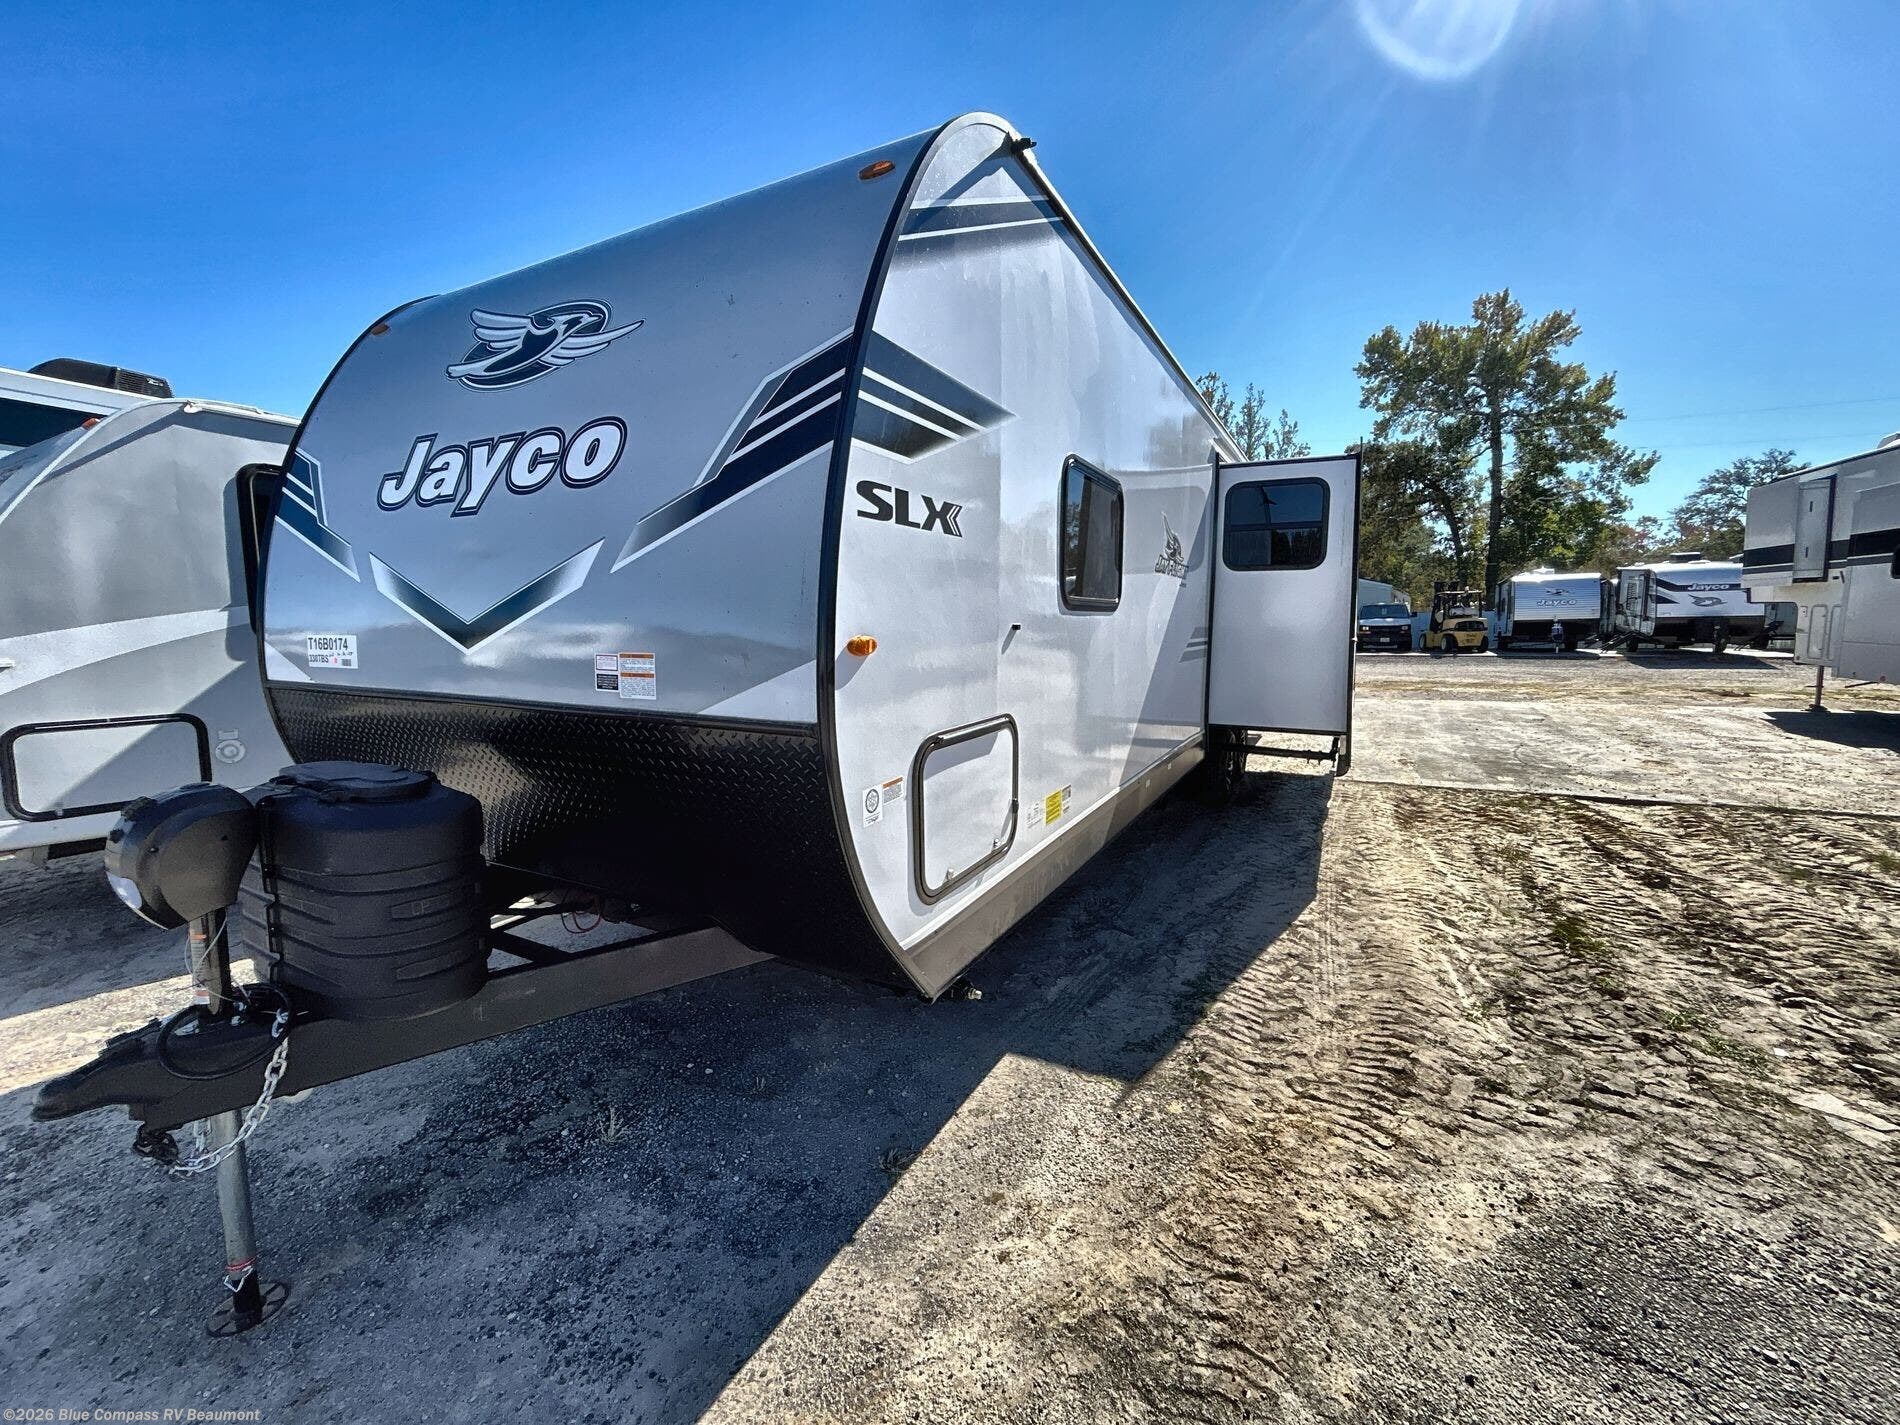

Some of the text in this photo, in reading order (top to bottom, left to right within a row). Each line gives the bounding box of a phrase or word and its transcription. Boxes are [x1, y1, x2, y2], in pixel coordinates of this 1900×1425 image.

[377, 415, 628, 518] Jayco
[856, 480, 963, 538] SLX
[1687, 582, 1730, 592] Jayco
[1536, 598, 1577, 607] Jayco
[308, 637, 349, 651] T16B0174
